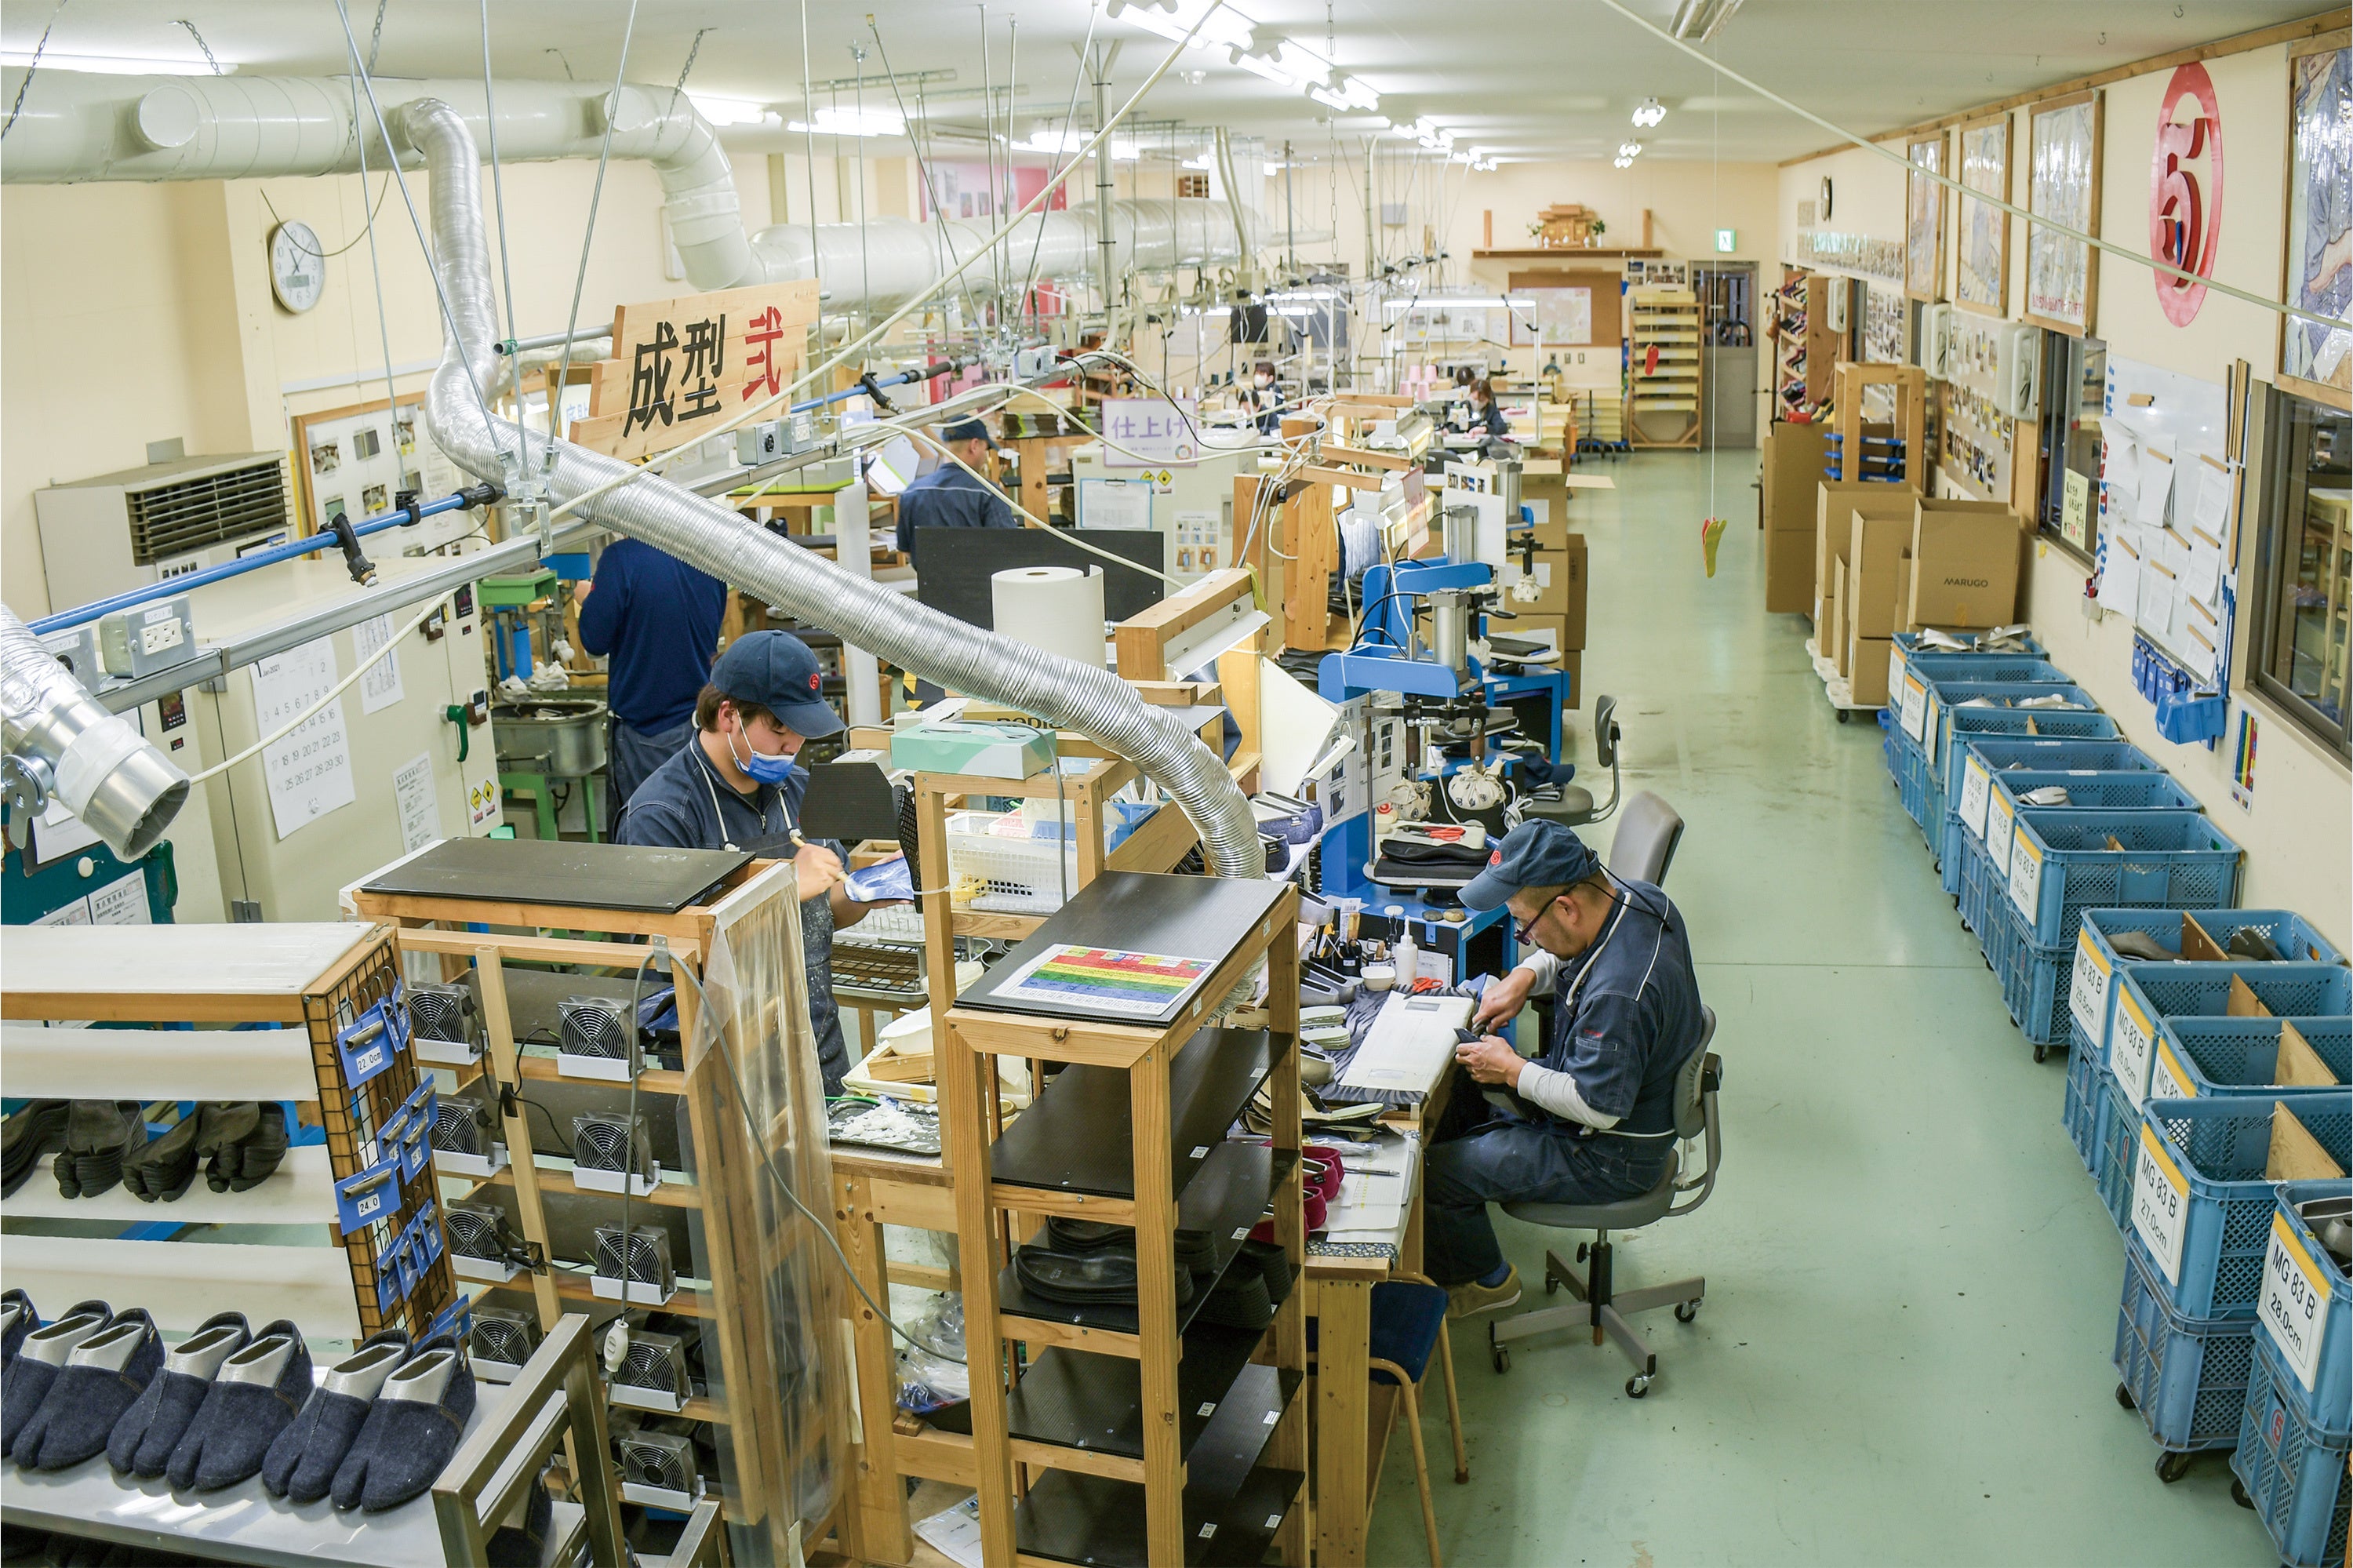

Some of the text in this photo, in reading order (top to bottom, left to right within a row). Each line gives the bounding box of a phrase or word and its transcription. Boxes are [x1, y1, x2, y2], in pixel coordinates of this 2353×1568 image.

[623, 314, 726, 438] 成型
[1944, 577, 1989, 588] MARUGO
[320, 661, 326, 673] 2
[274, 707, 280, 717] 4
[284, 702, 290, 713] 5
[295, 697, 301, 709] 6
[304, 693, 310, 705] 7
[314, 689, 320, 700] 8
[282, 754, 289, 766] 18
[292, 750, 300, 762] 19
[302, 744, 311, 757] 20
[312, 740, 320, 753] 21
[322, 735, 331, 748] 22
[332, 730, 340, 744] 23
[285, 754, 344, 791] 25 26 27 28 29 30
[2029, 863, 2035, 879] B
[2077, 951, 2103, 995] MG 83 B
[2076, 985, 2094, 1020] 25.5cm
[2118, 1008, 2144, 1058] MG 83 B
[358, 1050, 382, 1071] 22.0cm
[2157, 1064, 2169, 1095] MG
[2141, 1153, 2177, 1219] MG 83 B
[359, 1197, 379, 1213] 24.0
[2140, 1197, 2167, 1250] 27.0cm
[2272, 1243, 2316, 1320] MG 83 B
[2271, 1291, 2303, 1352] 28.0cm
